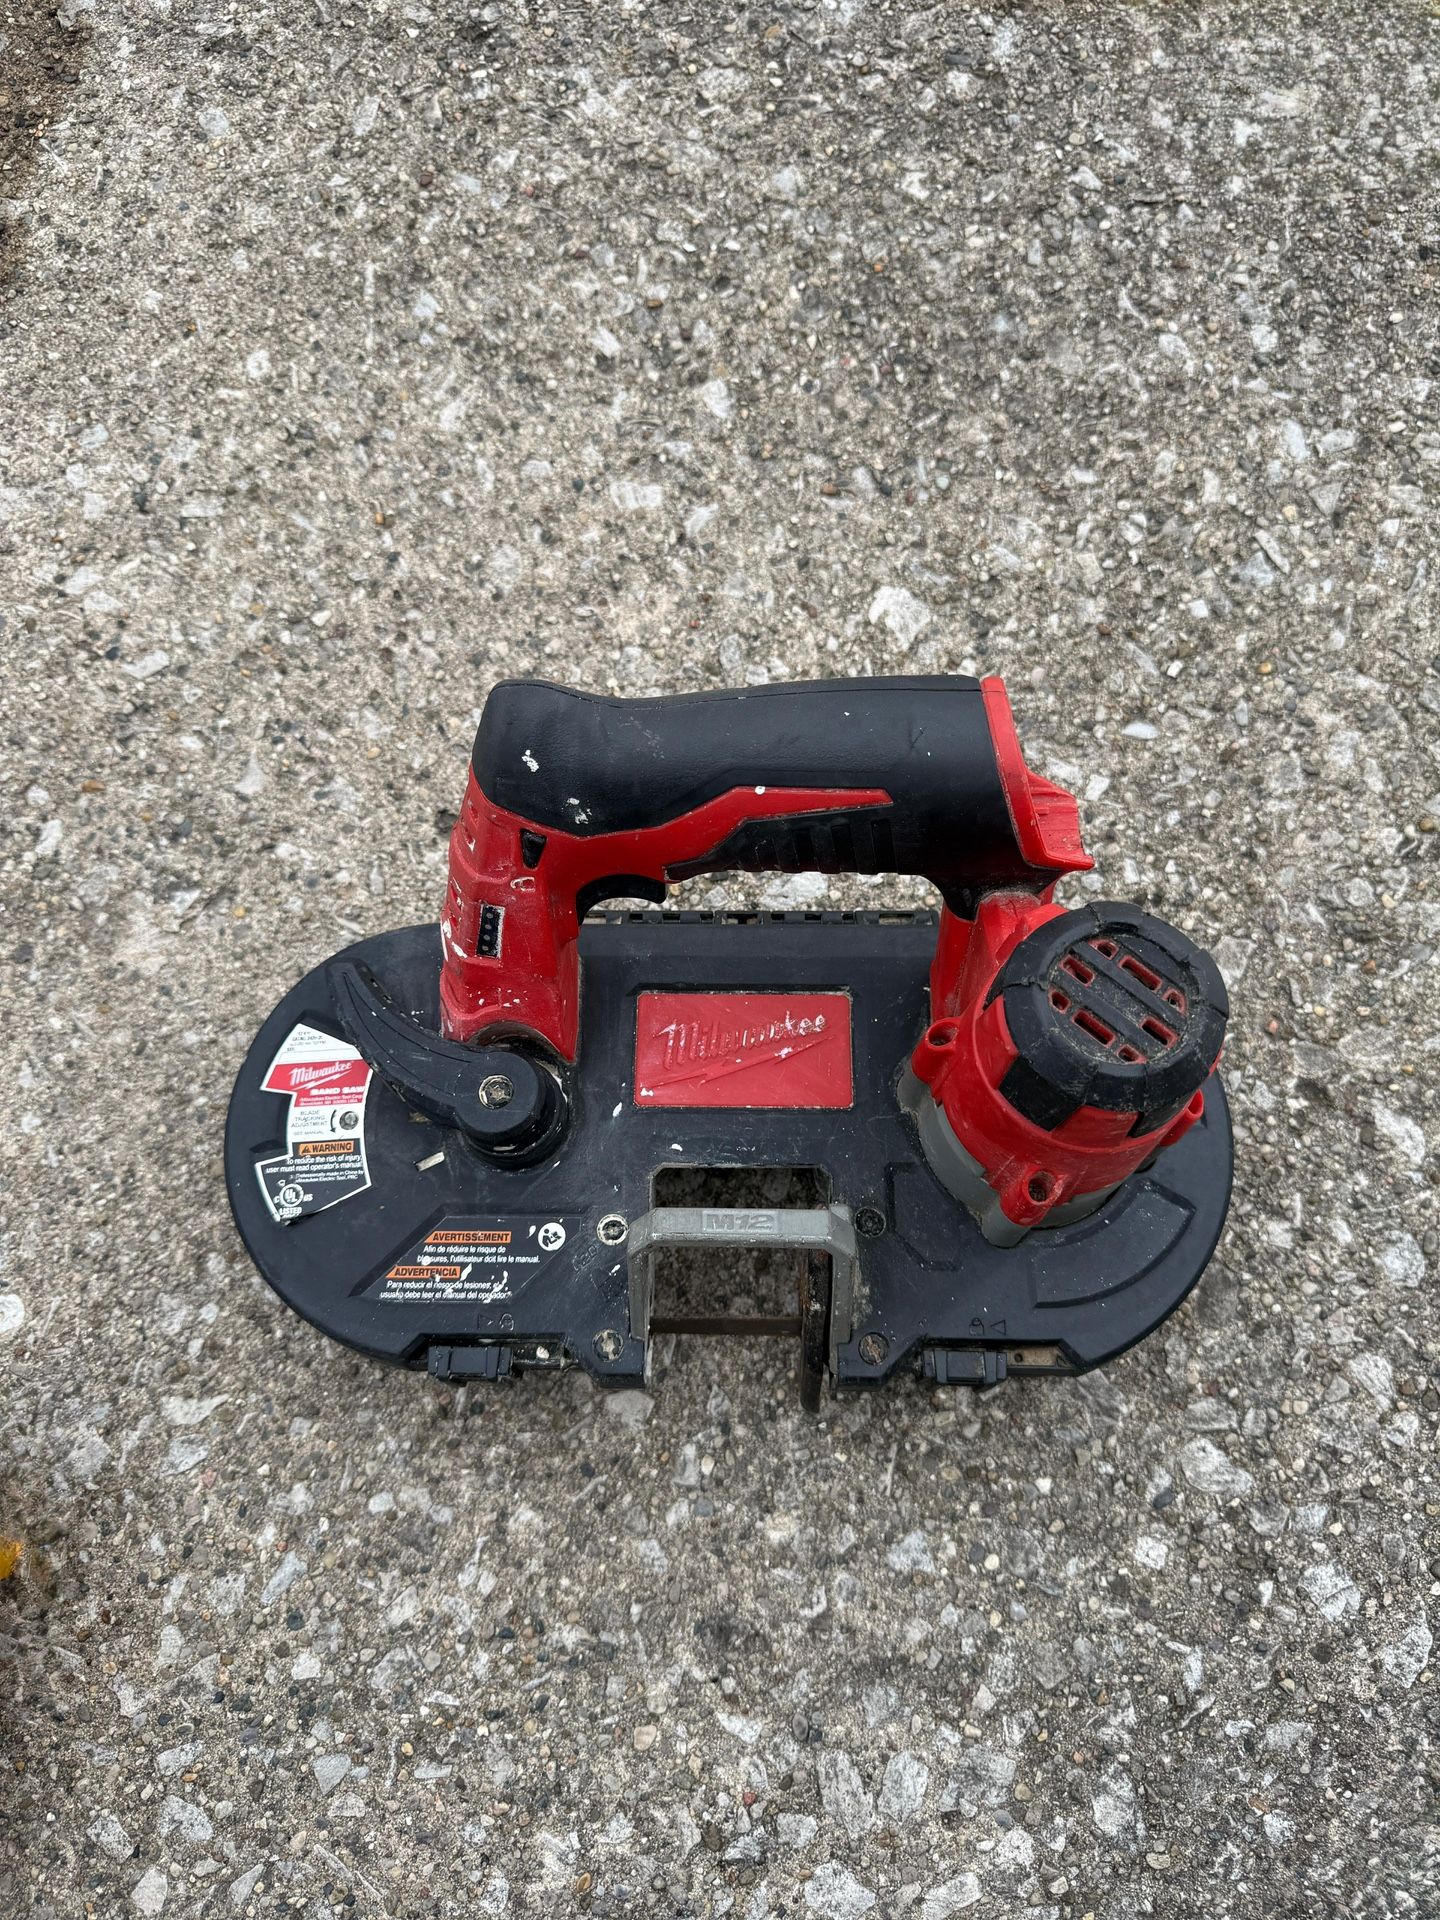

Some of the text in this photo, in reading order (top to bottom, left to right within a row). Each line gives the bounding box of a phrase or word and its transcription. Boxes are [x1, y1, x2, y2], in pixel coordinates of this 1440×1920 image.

[652, 1010, 827, 1071] Milwaukee
[288, 1061, 353, 1086] Milwaukee
[312, 1142, 352, 1153] WARNING
[286, 1157, 294, 1165] To
[294, 1156, 315, 1164] reduce
[337, 1154, 345, 1162] of
[280, 1164, 295, 1172] must
[295, 1163, 310, 1171] read
[310, 1162, 339, 1171] operator's
[706, 1214, 776, 1231] M12
[432, 1232, 510, 1241] AVERTISSEMENT
[423, 1244, 506, 1255] Afin de réduire le risque de
[450, 1254, 484, 1263] l'utilisateur
[484, 1255, 497, 1263] doit
[497, 1255, 508, 1263] lire
[508, 1255, 515, 1263] le
[515, 1255, 540, 1263] manual.
[394, 1267, 458, 1277] ADVERTENCIA
[386, 1280, 402, 1289] Para
[403, 1281, 426, 1289] reducir
[426, 1281, 433, 1289] el
[404, 1291, 421, 1299] debe
[421, 1291, 435, 1299] leer
[435, 1290, 443, 1299] el
[467, 1291, 478, 1299] del
